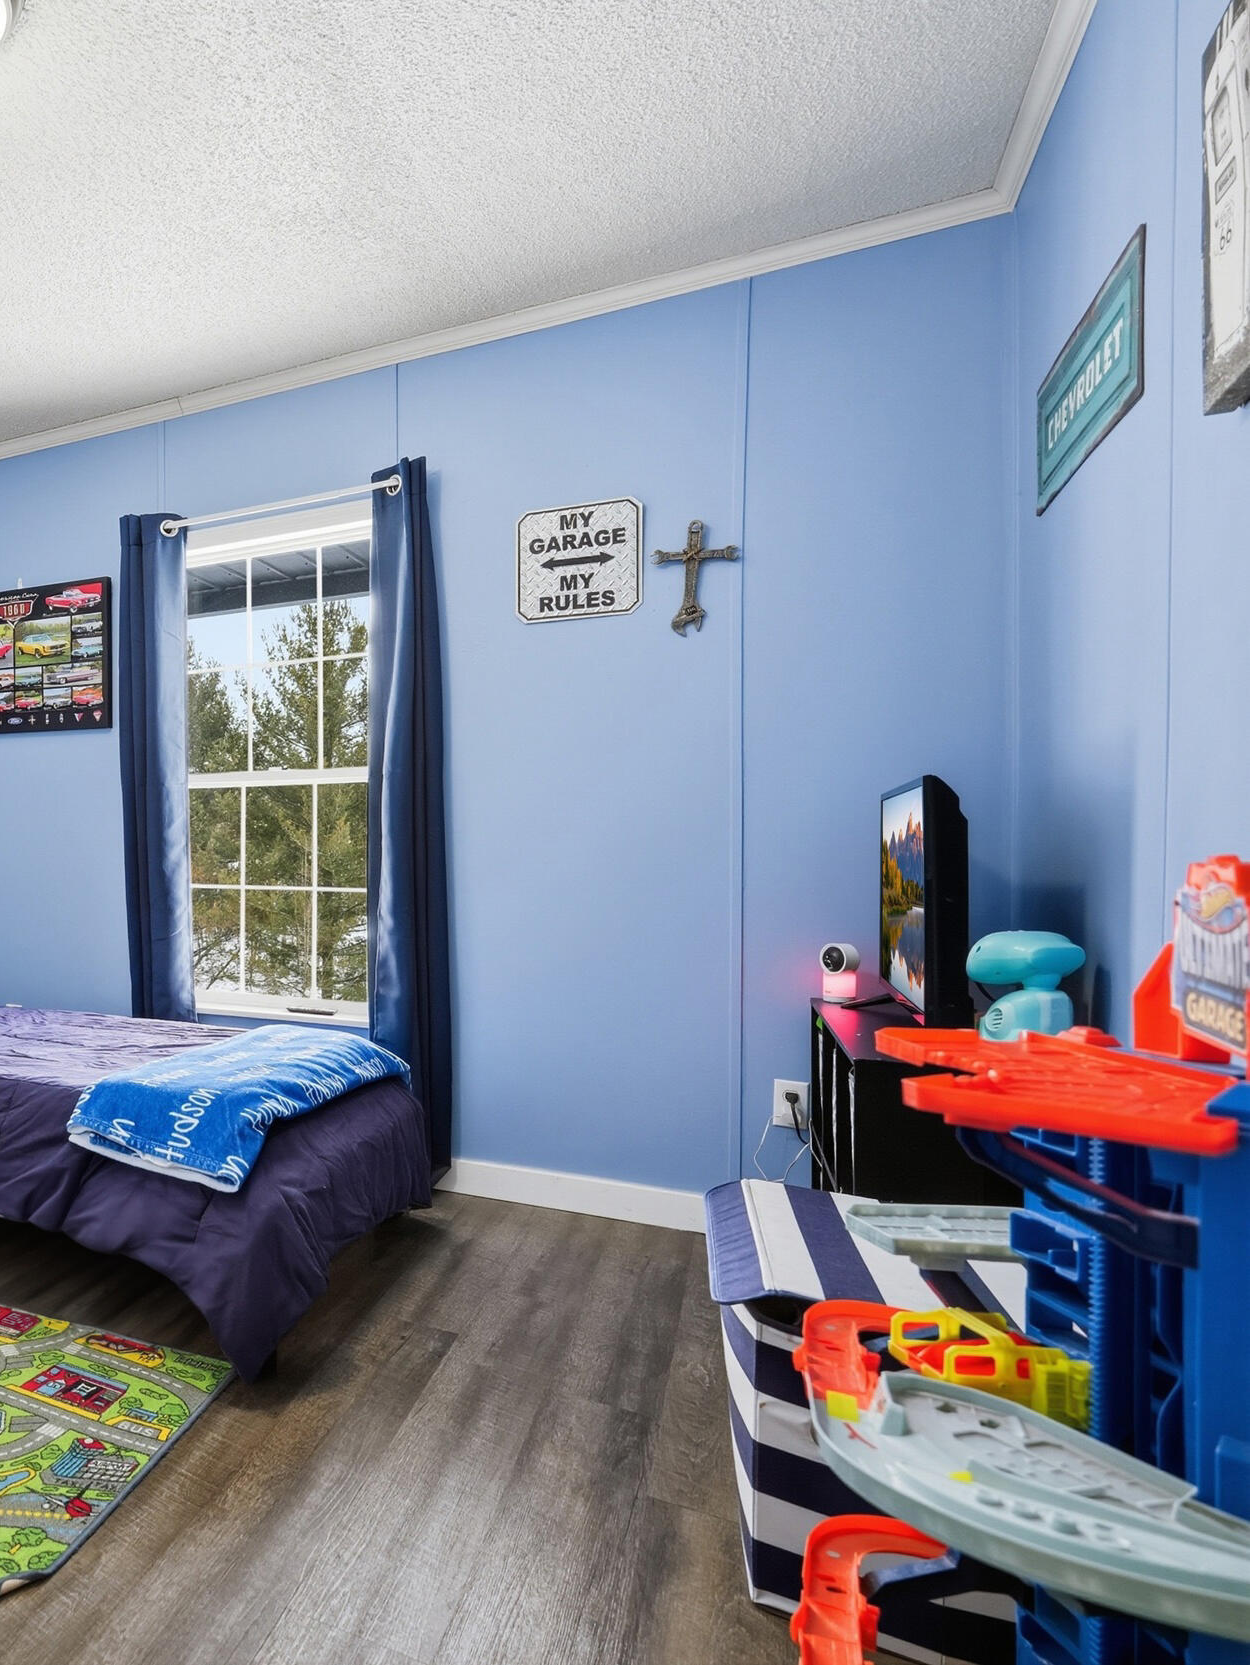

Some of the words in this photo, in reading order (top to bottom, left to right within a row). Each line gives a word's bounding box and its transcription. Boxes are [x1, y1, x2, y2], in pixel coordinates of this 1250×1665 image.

[1048, 317, 1124, 450] CHEVROLET
[559, 511, 594, 531] MY
[528, 527, 626, 554] GARAGE
[559, 572, 594, 591] MY
[539, 590, 615, 613] RULES
[1186, 992, 1245, 1042] GARAGE
[118, 1421, 154, 1437] BUS
